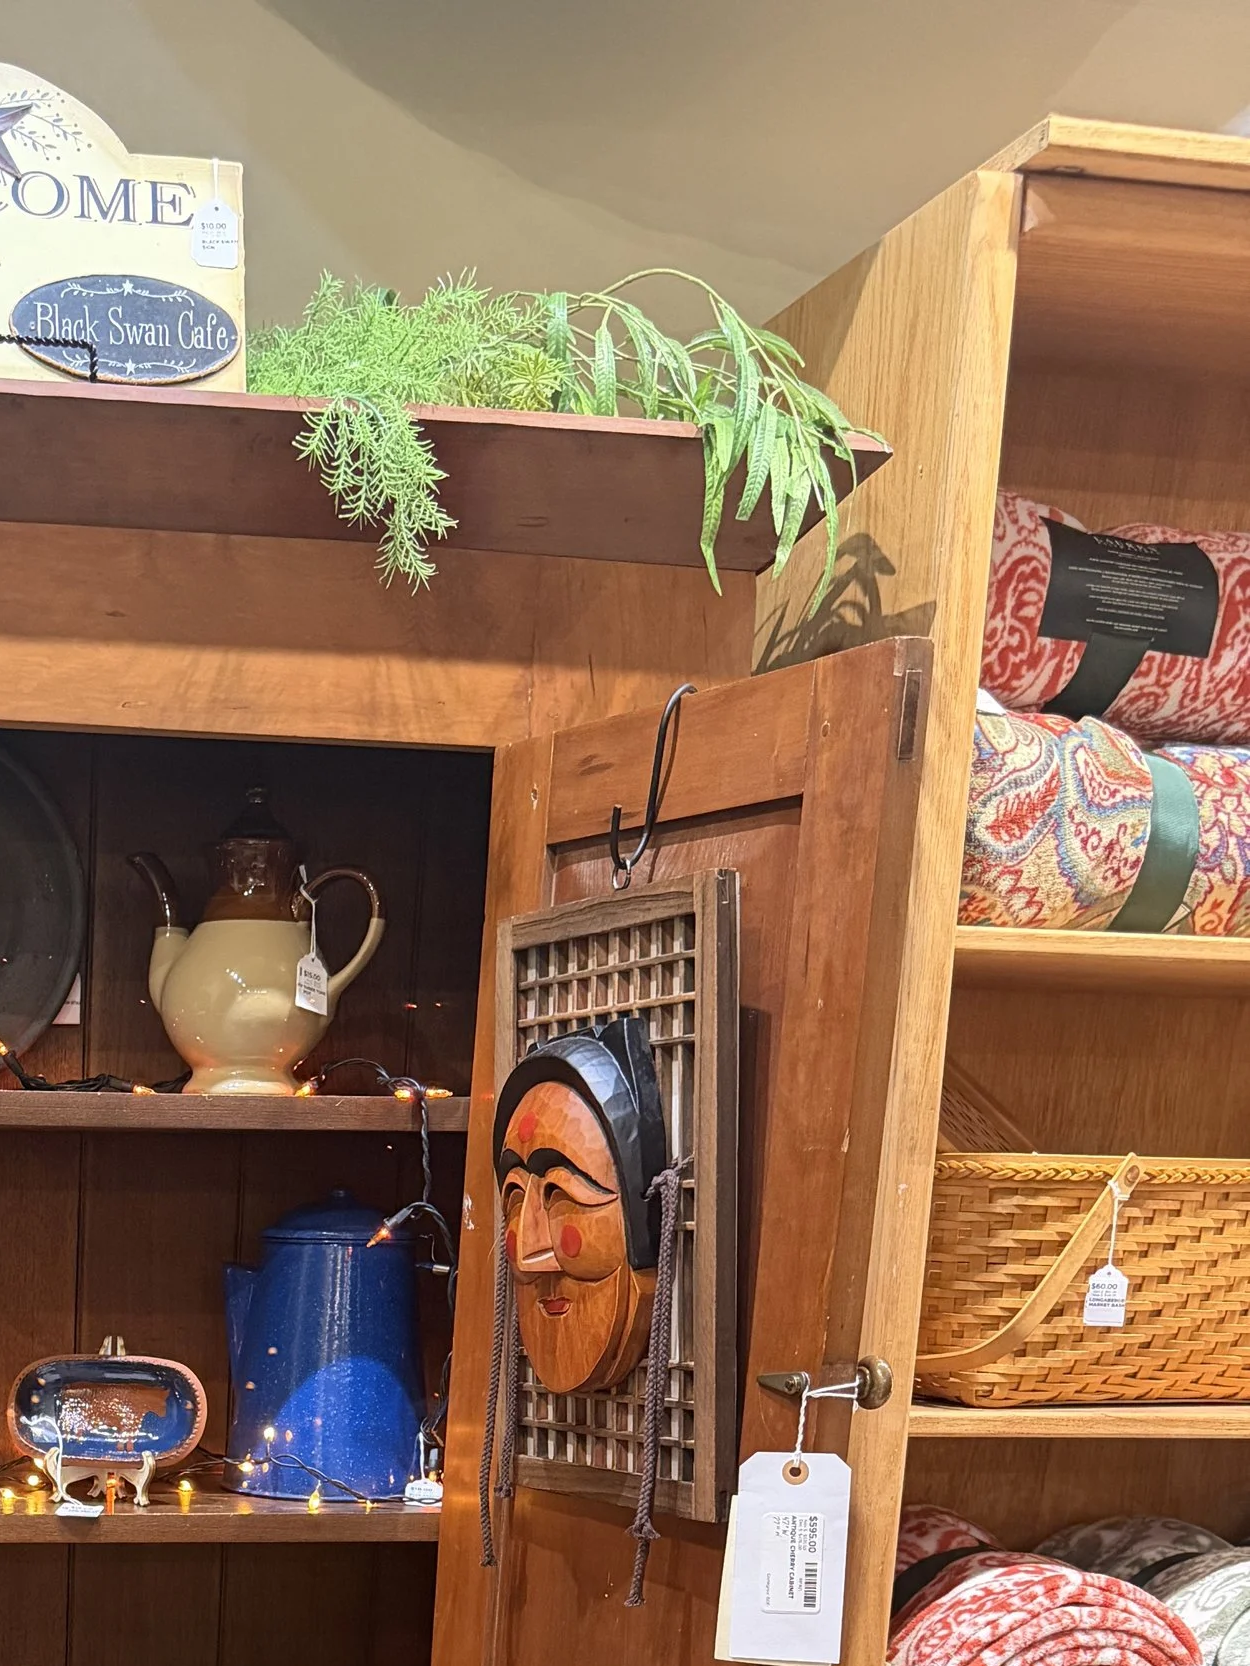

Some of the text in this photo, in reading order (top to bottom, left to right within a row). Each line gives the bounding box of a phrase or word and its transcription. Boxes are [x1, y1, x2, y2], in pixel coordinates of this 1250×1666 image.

[201, 222, 227, 230] $10.00
[34, 301, 229, 351] Black Swan Cafe
[1091, 1282, 1118, 1290] $60.00
[808, 1515, 818, 1554] $595.00
[789, 1545, 797, 1572] CHERRY
